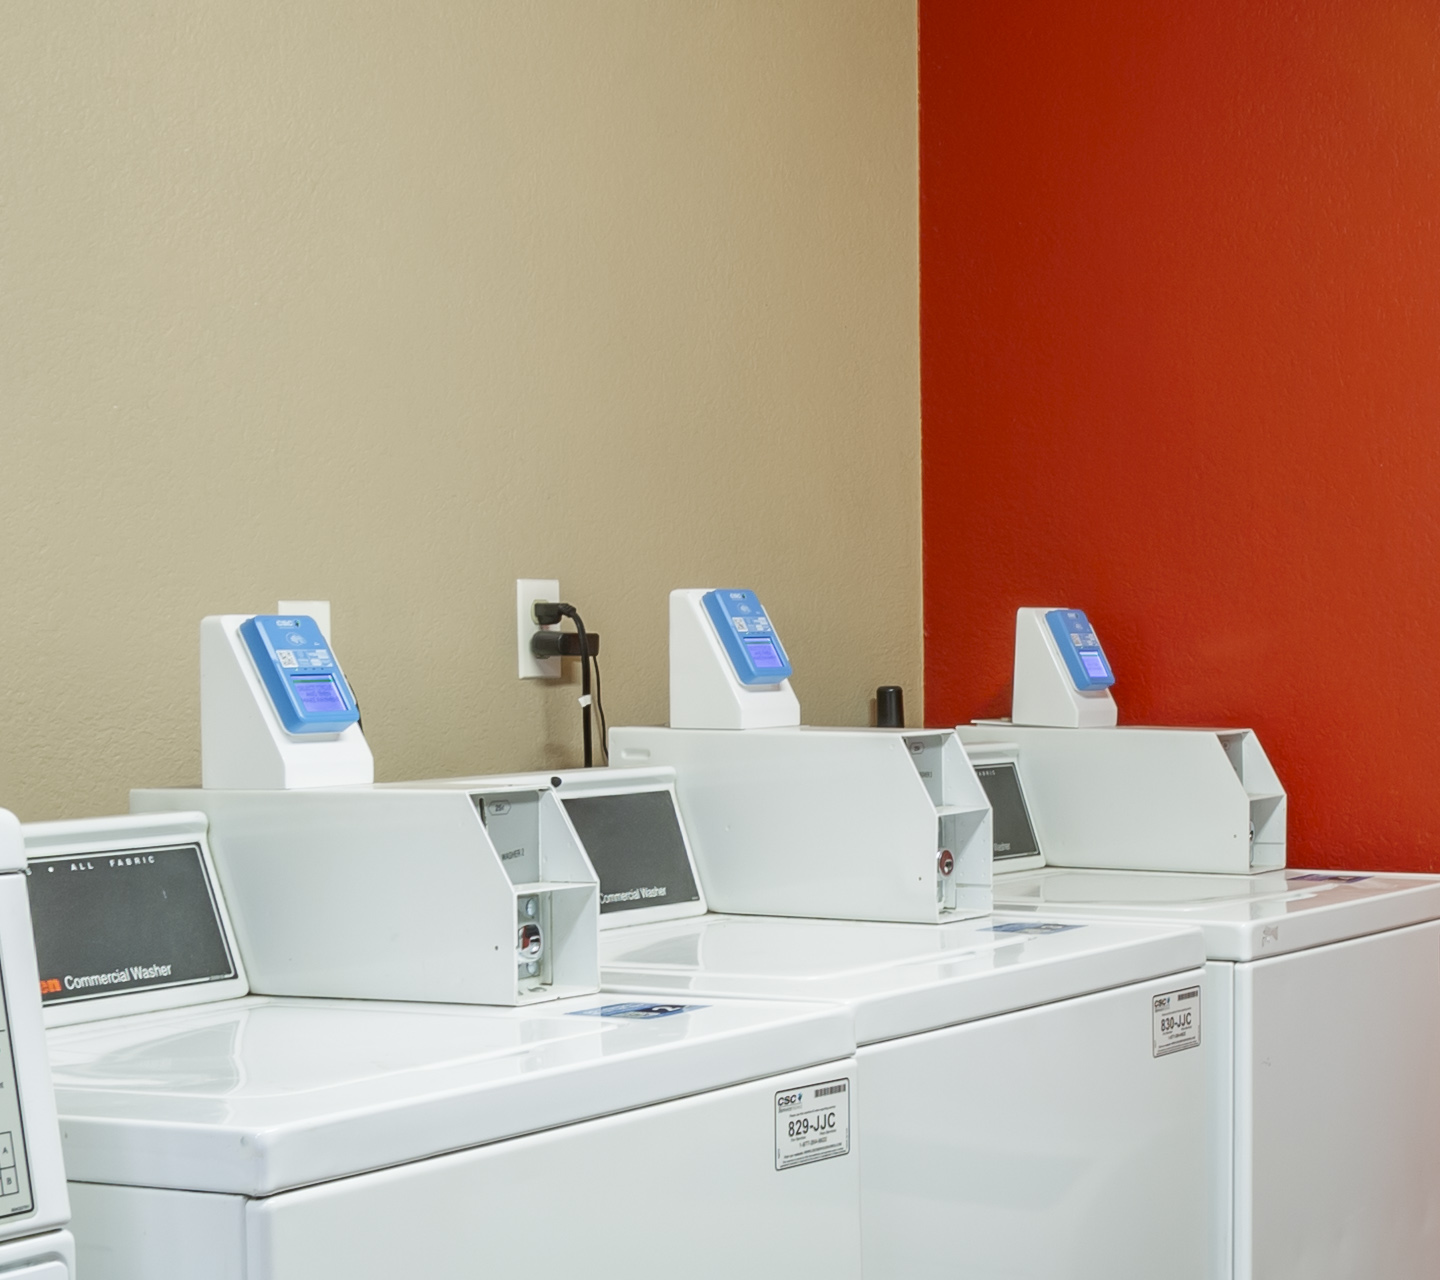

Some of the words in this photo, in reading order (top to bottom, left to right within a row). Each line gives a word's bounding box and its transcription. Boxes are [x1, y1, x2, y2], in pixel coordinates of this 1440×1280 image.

[70, 861, 94, 871] ALL
[109, 855, 155, 868] FABRIC
[501, 849, 520, 861] WASHER
[599, 888, 640, 904] Commercial
[640, 886, 667, 900] Washer
[64, 968, 131, 990] Commercial
[130, 964, 172, 980] Washer
[1161, 1012, 1192, 1032] 830-JJC
[777, 1094, 797, 1107] CSC
[788, 1112, 836, 1137] 829-JJC
[2, 1147, 8, 1155] A
